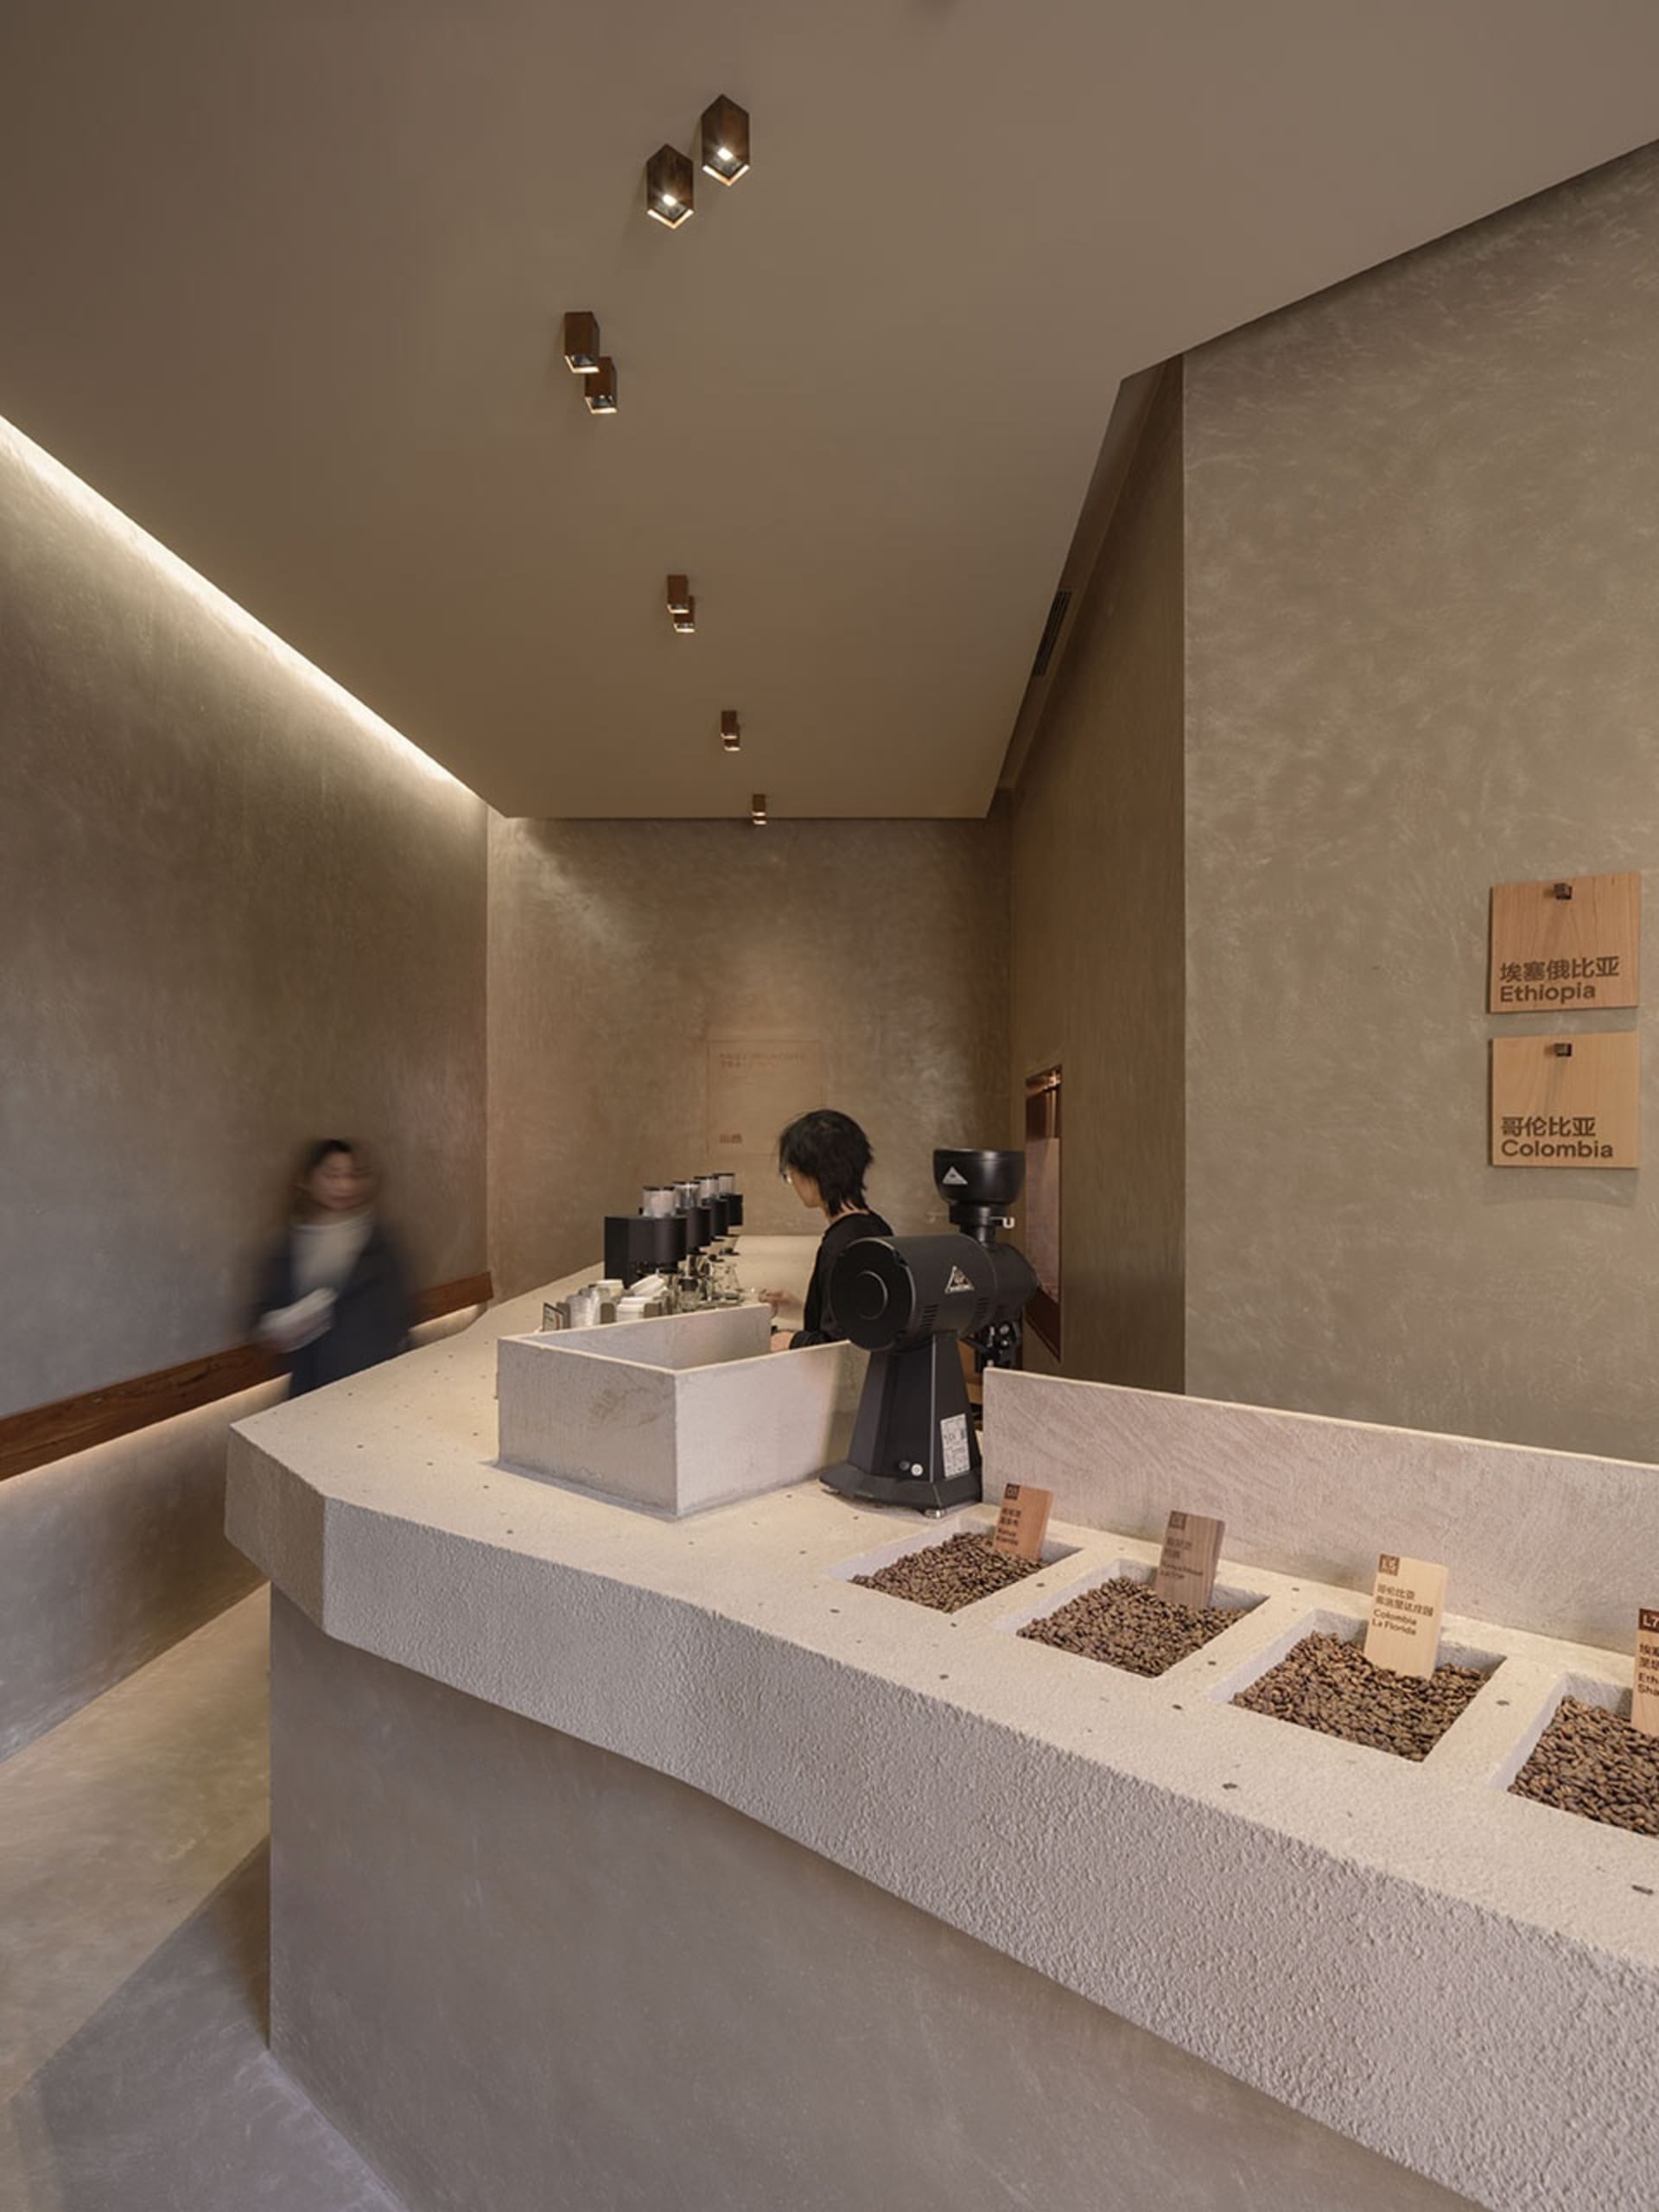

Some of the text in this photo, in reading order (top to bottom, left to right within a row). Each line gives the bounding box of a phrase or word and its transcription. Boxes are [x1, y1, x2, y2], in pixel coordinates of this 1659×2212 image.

[1499, 956, 1619, 982] 埃塞俄比亚
[1500, 982, 1596, 1004] Ethiopia
[1502, 1116, 1596, 1137] 哥伦比亚
[1501, 1140, 1613, 1159] Colombia
[1374, 1609, 1416, 1625] Colombia
